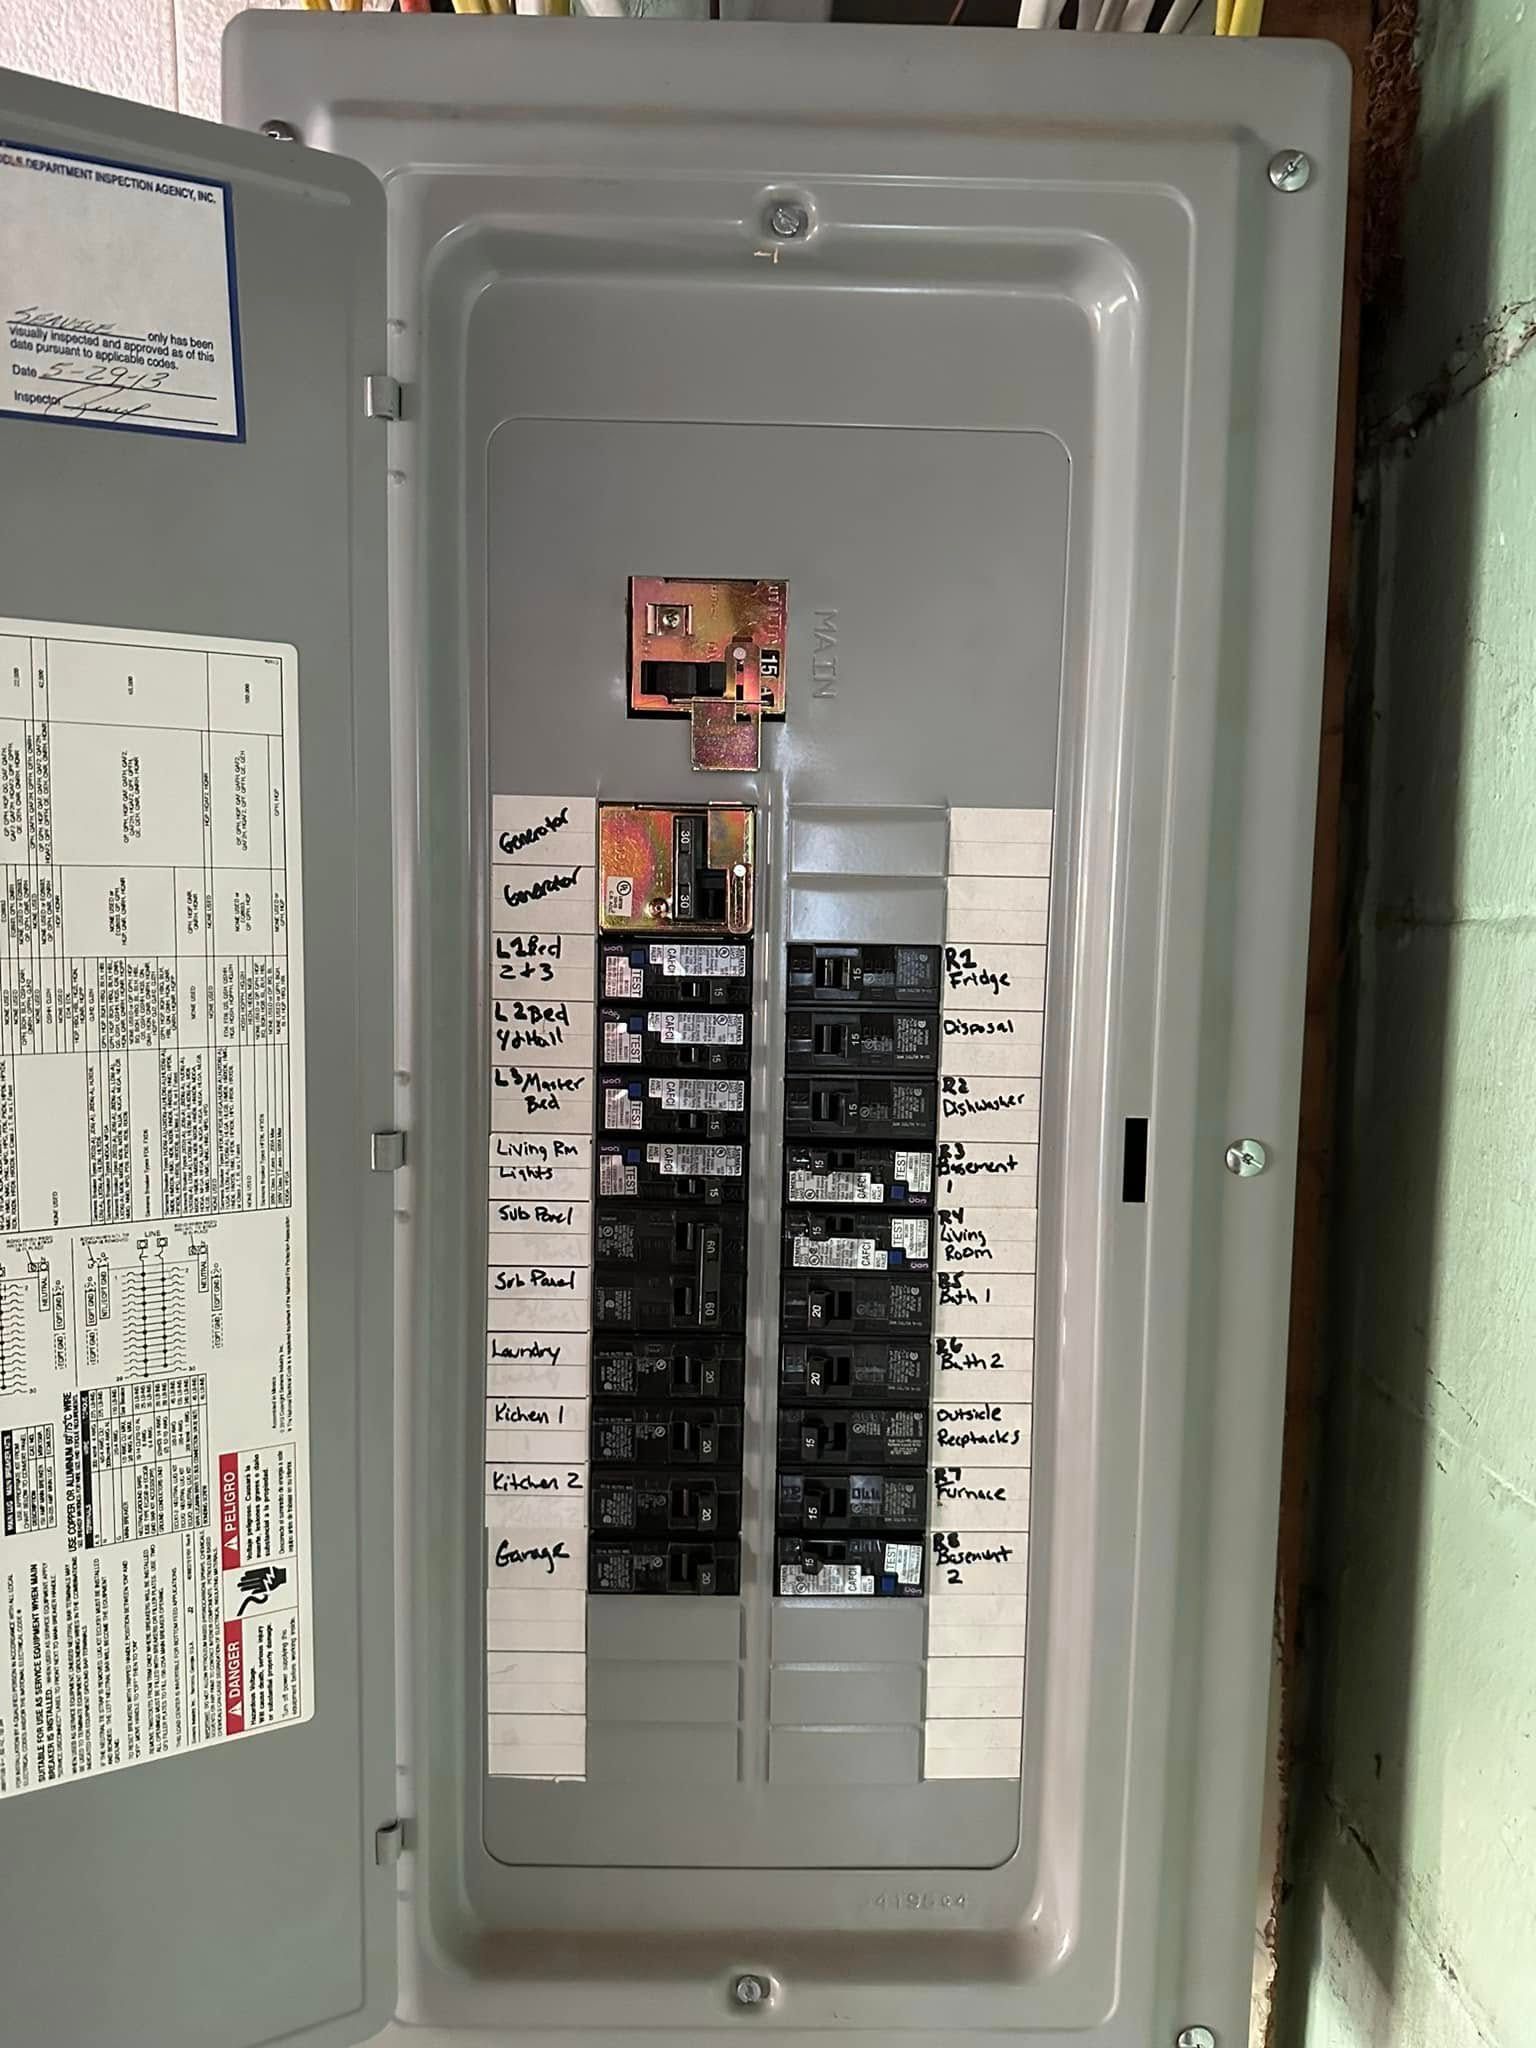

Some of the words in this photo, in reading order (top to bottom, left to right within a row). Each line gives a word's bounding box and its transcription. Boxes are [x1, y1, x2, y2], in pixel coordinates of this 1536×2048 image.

[26, 158, 93, 180] DEPARTMENT
[95, 171, 153, 192] INSPECTION
[155, 183, 196, 202] AGENCY,
[197, 190, 216, 204] INC.
[10, 325, 47, 342] visually
[51, 330, 99, 347] inspected
[102, 338, 121, 350] and
[124, 341, 169, 356] approved
[172, 349, 183, 358] as
[185, 350, 196, 360] of
[197, 352, 215, 362] this
[147, 332, 168, 345] only
[170, 334, 188, 346] has
[190, 337, 214, 350] been
[10, 339, 33, 352] date
[36, 343, 80, 357] pursuant
[83, 347, 93, 358] to
[96, 350, 145, 365] applicable
[147, 357, 179, 370] codes.
[12, 364, 37, 378] Date
[14, 390, 60, 405] Inspector
[812, 609, 838, 699] MAIN
[500, 807, 568, 854] Generator
[680, 830, 690, 844] 30
[504, 866, 582, 907] Generator
[680, 894, 690, 908] 30
[667, 948, 676, 973] CAFCI
[945, 948, 977, 970] R1
[500, 964, 516, 980] 2
[540, 962, 554, 981] 3
[853, 968, 862, 980] 15
[632, 971, 641, 996] TEST
[714, 987, 724, 998] 15
[949, 973, 1011, 995] Fridge
[664, 1015, 674, 1040] CAFCI
[944, 1018, 1014, 1035] Disposal
[631, 1036, 640, 1062] TEST
[852, 1033, 860, 1046] 15
[711, 1053, 721, 1064] 15
[666, 1081, 675, 1106] CAFCI
[942, 1077, 969, 1095] R2
[632, 1102, 641, 1128] TEST
[849, 1103, 857, 1116] 15
[710, 1120, 720, 1131] 15
[497, 1139, 548, 1161] Living
[553, 1140, 578, 1157] Rm
[939, 1143, 965, 1160] R3
[664, 1147, 673, 1173] CAFCI
[814, 1159, 824, 1169] 15
[896, 1153, 906, 1178] TEST
[499, 1164, 553, 1179] Lights
[627, 1167, 636, 1193] TEST
[708, 1187, 719, 1198] 15
[857, 1175, 866, 1199] CAFCI
[498, 1204, 531, 1221] Sub
[937, 1207, 965, 1225] R4
[144, 1229, 161, 1237] LINE
[812, 1226, 822, 1236] 15
[893, 1220, 902, 1246] TEST
[940, 1227, 986, 1247] Living
[862, 1241, 872, 1266] CAFCI
[945, 1247, 993, 1262] Room
[494, 1271, 525, 1290] Sub
[940, 1288, 978, 1306] Bath
[704, 1302, 715, 1317] 60
[811, 1304, 822, 1319] 20
[492, 1338, 561, 1366] Laundry
[991, 1353, 1005, 1370] 2
[705, 1370, 715, 1384] 20
[810, 1372, 821, 1386] 20
[63, 1391, 72, 1412] WIRE
[702, 1440, 712, 1453] 20
[805, 1437, 815, 1449] 15
[65, 1447, 74, 1487] ALUMINUM
[493, 1470, 558, 1491] Kitchen
[567, 1472, 584, 1490] 2
[66, 1489, 75, 1501] OR
[936, 1481, 1007, 1502] Furnace
[224, 1472, 236, 1533] PELIGRO
[66, 1503, 76, 1535] COPPER
[701, 1507, 711, 1521] 20
[808, 1507, 818, 1520] 15
[68, 1537, 77, 1553] USE
[495, 1539, 569, 1574] Garage
[804, 1557, 814, 1567] 15
[886, 1545, 896, 1570] TEST
[30, 1563, 38, 1584] MAIN
[701, 1571, 711, 1585] 20
[848, 1567, 857, 1592] CAFCI
[947, 1569, 963, 1584] 2
[30, 1587, 38, 1610] WHEN
[32, 1613, 41, 1659] EQUIPMENT
[33, 1660, 42, 1695] SERVICE
[228, 1640, 240, 1699] DANGER
[35, 1697, 42, 1707] AS
[45, 1686, 53, 1731] INSTALLED.
[36, 1726, 44, 1743] FOR
[47, 1732, 54, 1741] IS
[37, 1744, 45, 1782] SUITABLE
